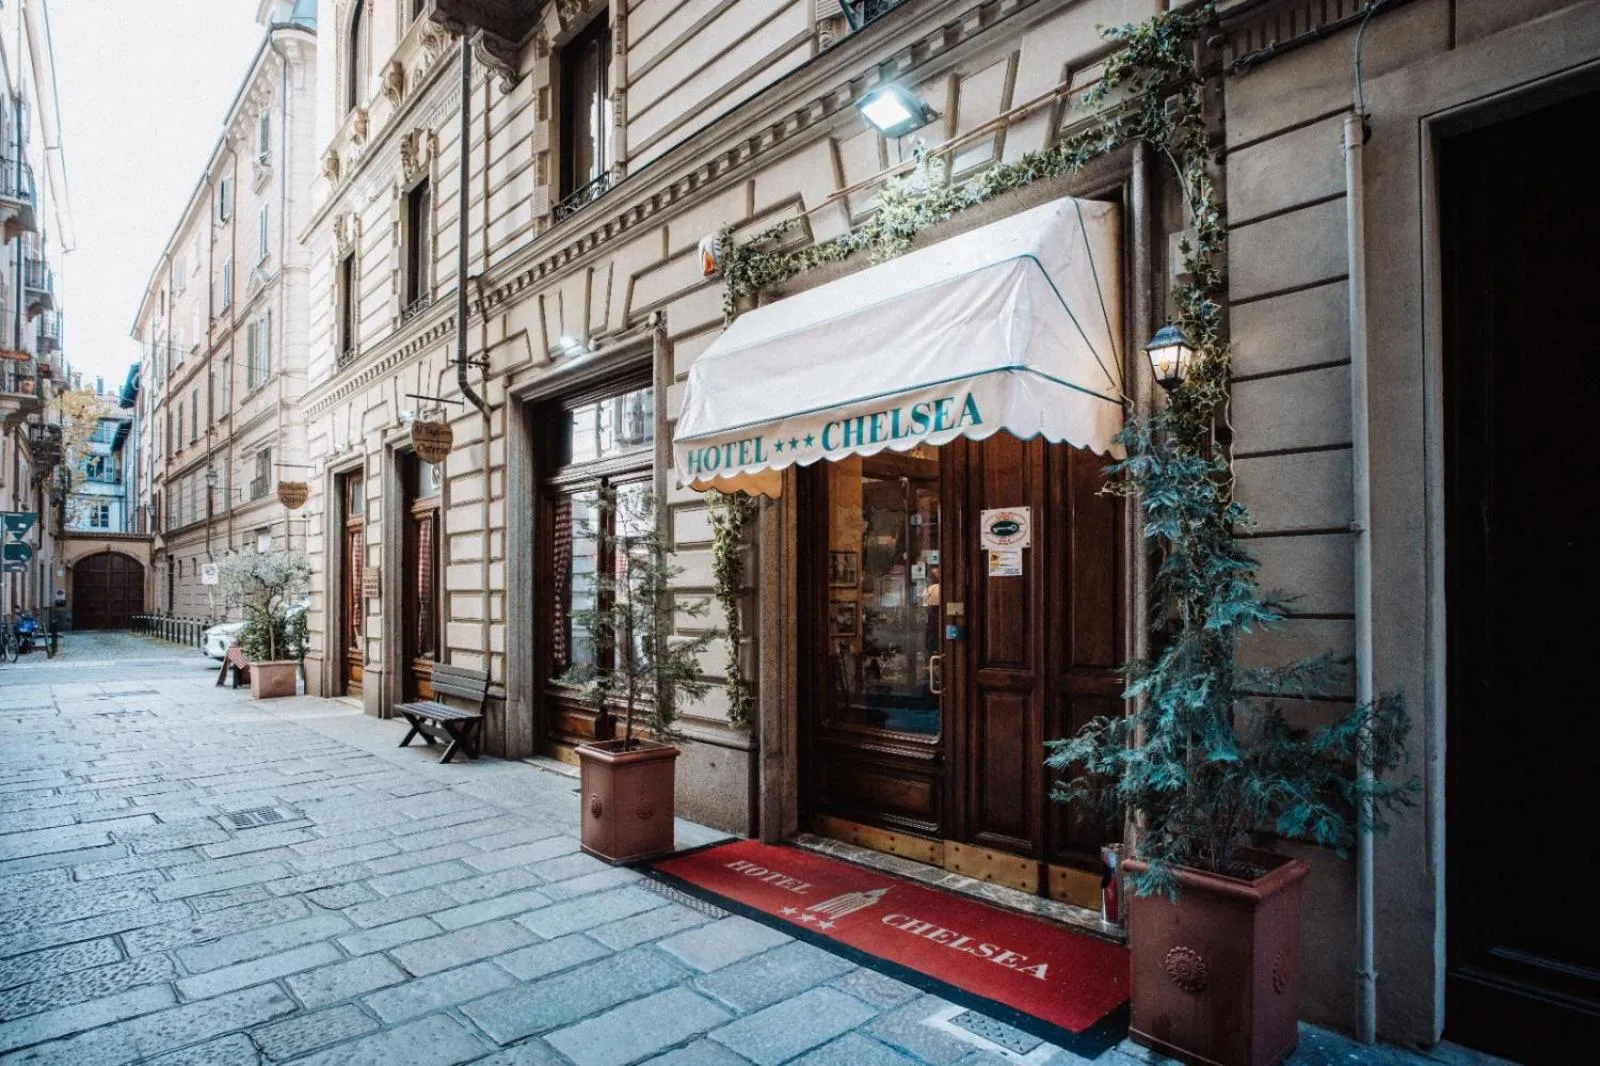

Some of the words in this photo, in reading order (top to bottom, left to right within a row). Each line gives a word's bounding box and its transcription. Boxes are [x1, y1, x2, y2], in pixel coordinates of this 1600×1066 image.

[687, 436, 768, 475] HOTEL
[820, 392, 983, 452] CHELSEA
[727, 860, 817, 895] HOTEL
[881, 914, 1049, 981] CHELSEA
